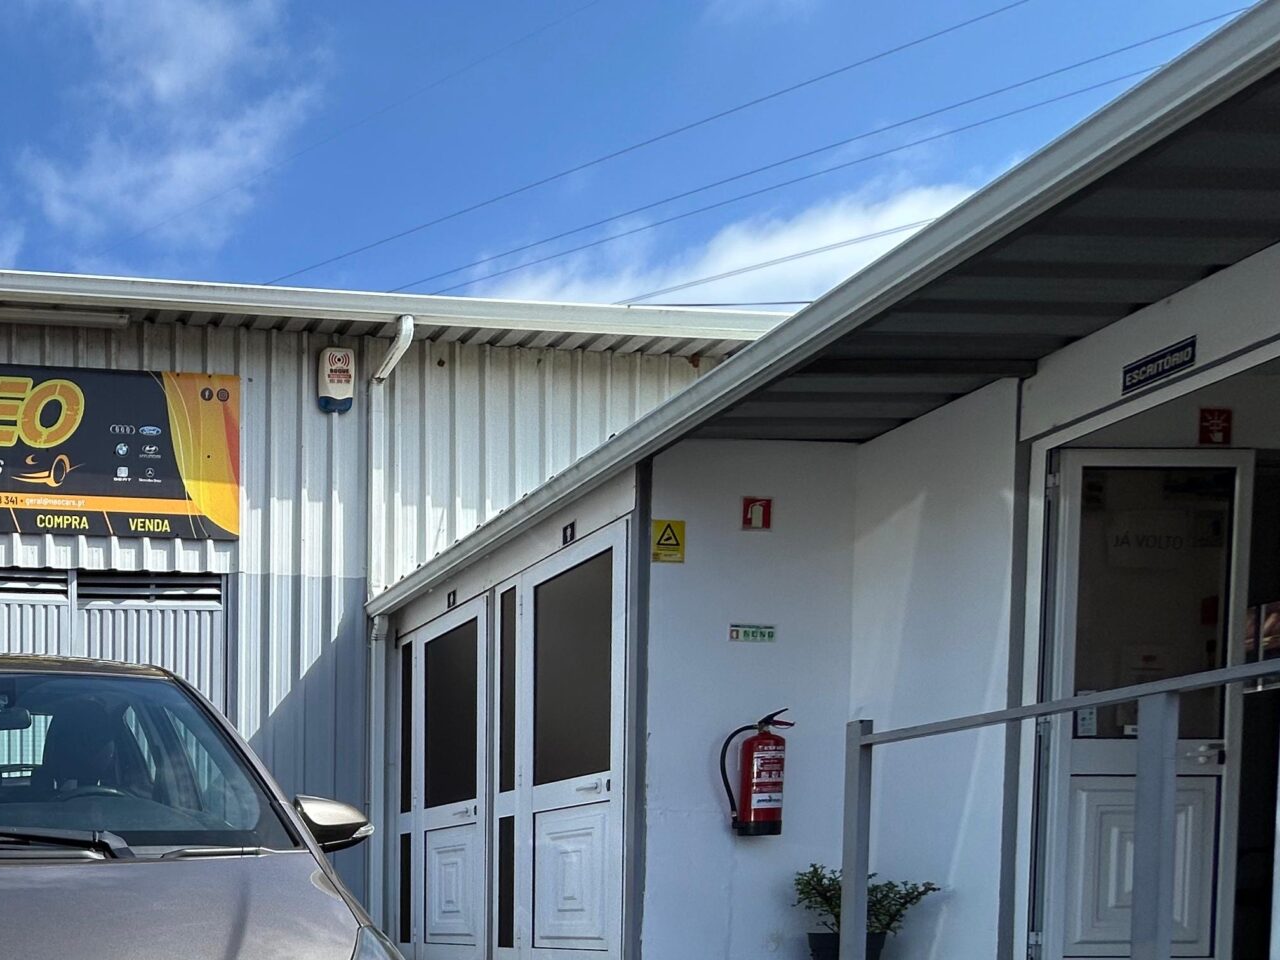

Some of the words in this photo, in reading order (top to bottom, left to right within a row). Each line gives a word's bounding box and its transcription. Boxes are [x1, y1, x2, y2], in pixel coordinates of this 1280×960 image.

[1125, 346, 1193, 386] ESCRITÓRIO
[4, 496, 18, 506] 341
[36, 514, 89, 529] COMPRA
[129, 518, 170, 532] VENDA
